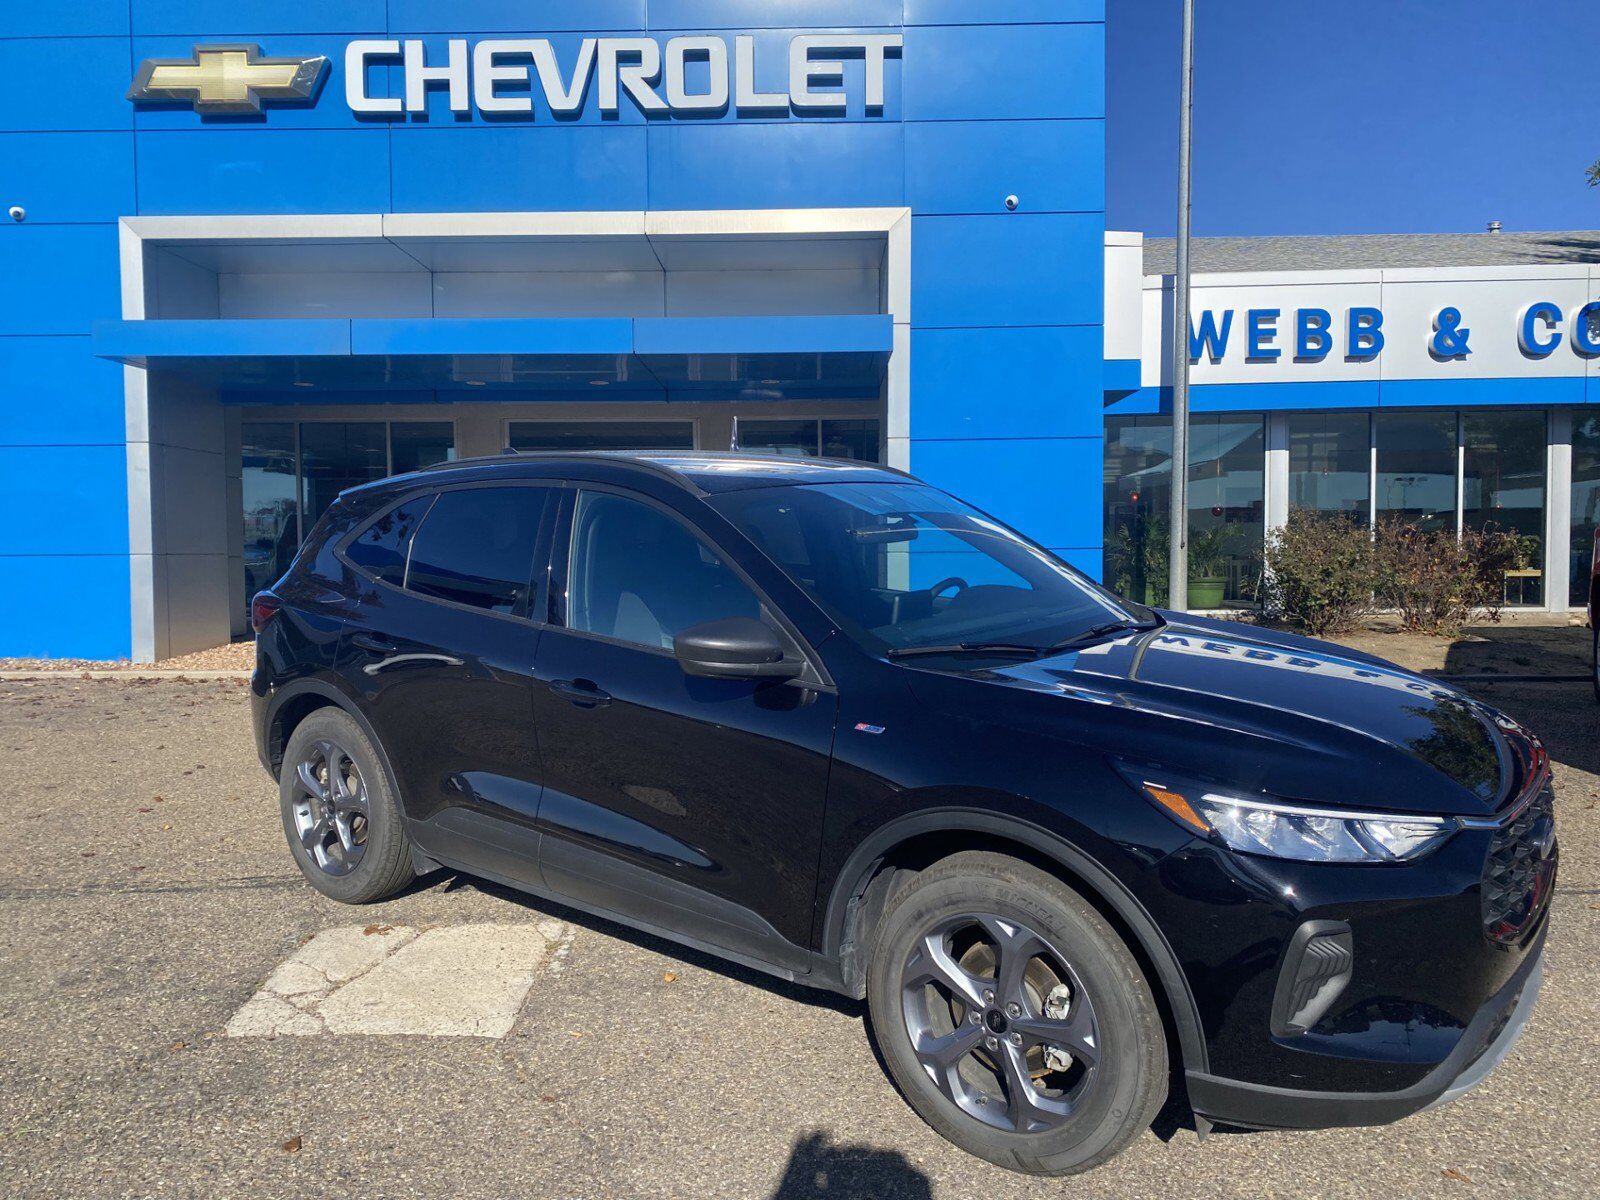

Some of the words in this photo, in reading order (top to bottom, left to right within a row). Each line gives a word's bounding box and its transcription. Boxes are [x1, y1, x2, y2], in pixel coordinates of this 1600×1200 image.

[345, 34, 904, 118] CHEVROLET
[1190, 305, 1385, 360] WEBB
[1430, 305, 1474, 359] &
